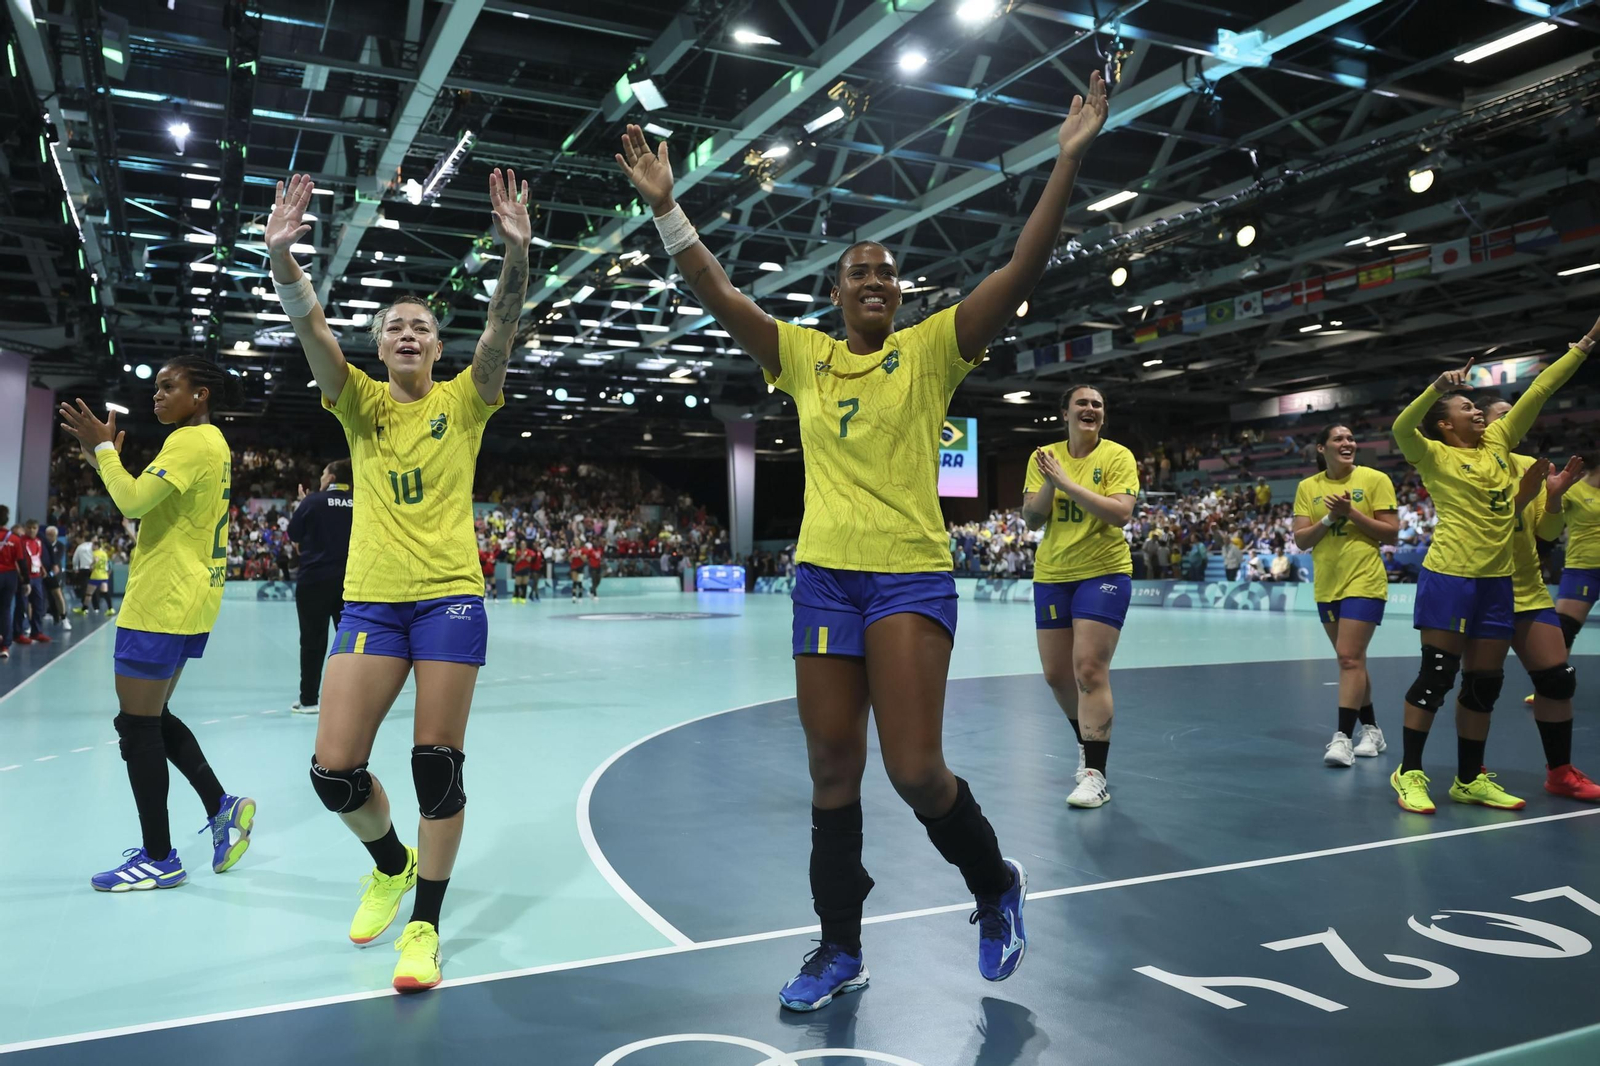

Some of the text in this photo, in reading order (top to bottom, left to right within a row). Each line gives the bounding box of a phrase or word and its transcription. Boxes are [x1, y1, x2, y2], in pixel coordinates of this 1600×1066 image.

[838, 397, 859, 437] 7
[940, 453, 964, 468] RA
[388, 467, 423, 505] 10
[1138, 588, 1160, 597] 2024
